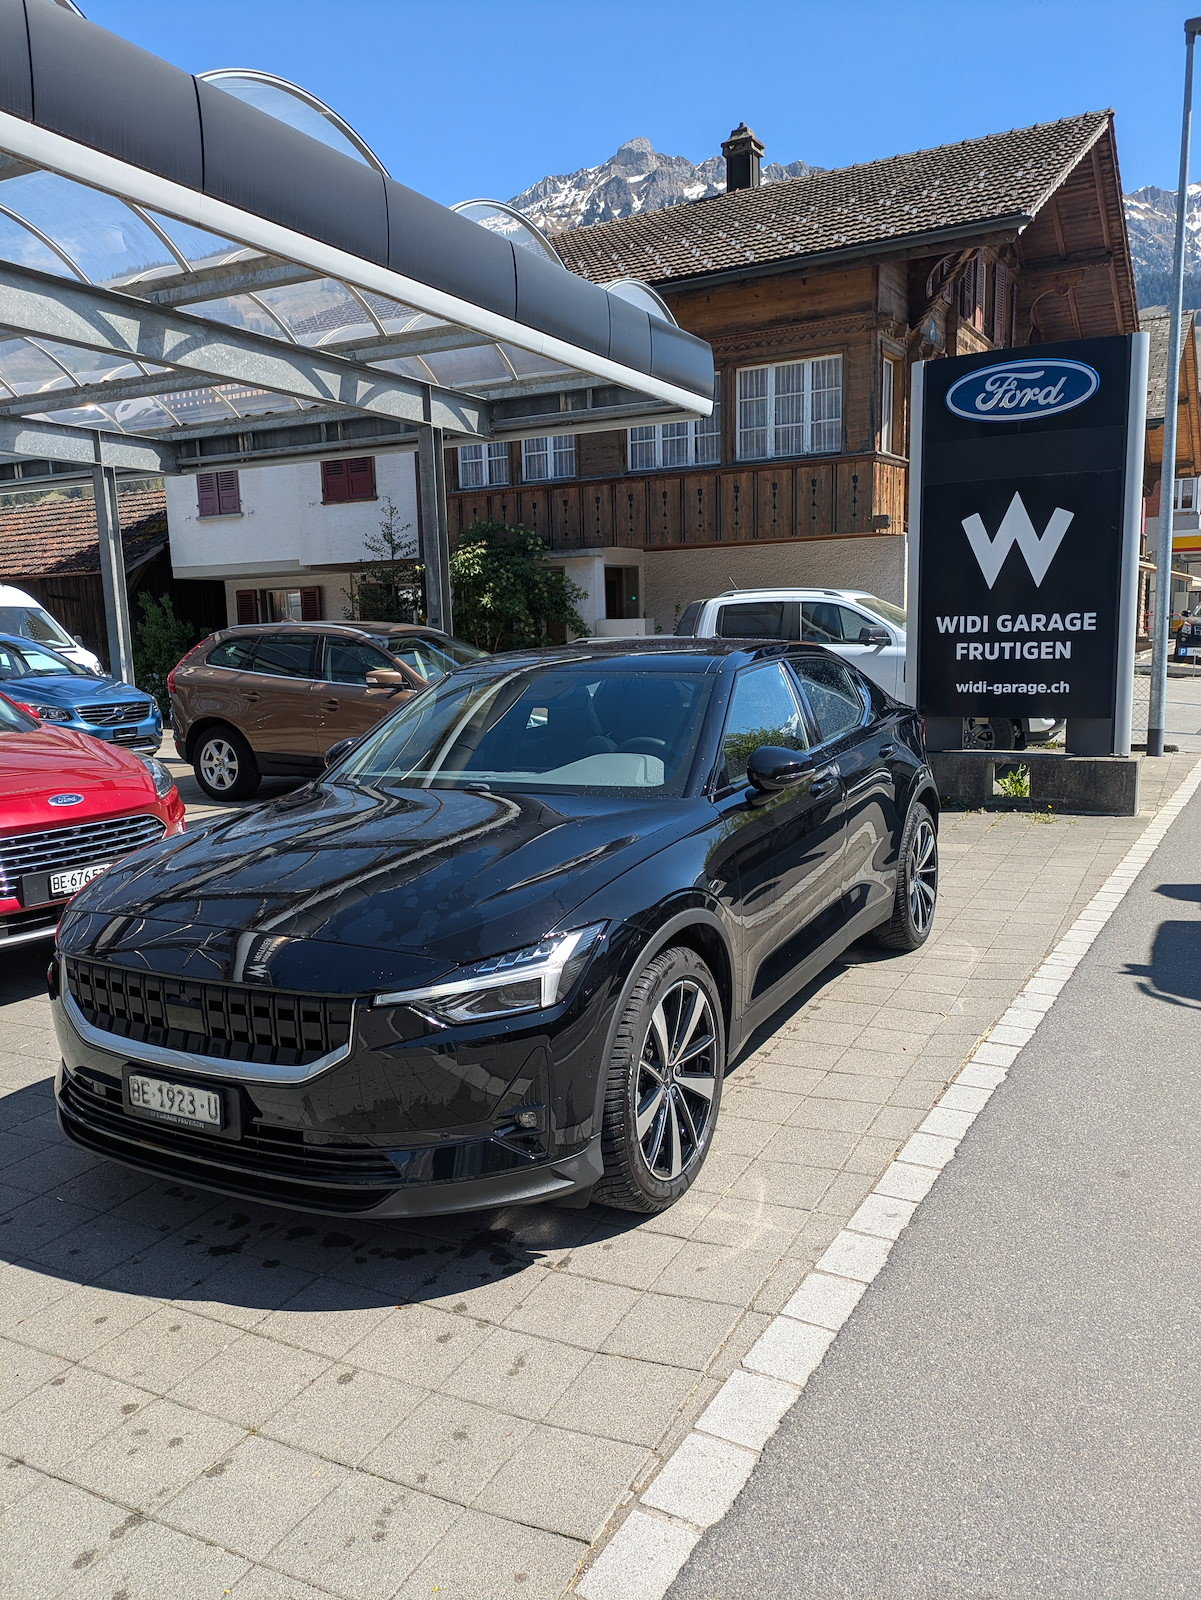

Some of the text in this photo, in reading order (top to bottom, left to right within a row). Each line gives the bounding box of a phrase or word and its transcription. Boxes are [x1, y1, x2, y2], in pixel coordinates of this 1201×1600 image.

[975, 370, 1067, 411] Ford
[961, 490, 1074, 590] W
[936, 612, 1097, 633] WIDI GARAGE
[956, 641, 1072, 660] FRUTIGEN
[956, 681, 1070, 695] widi-garage.ch
